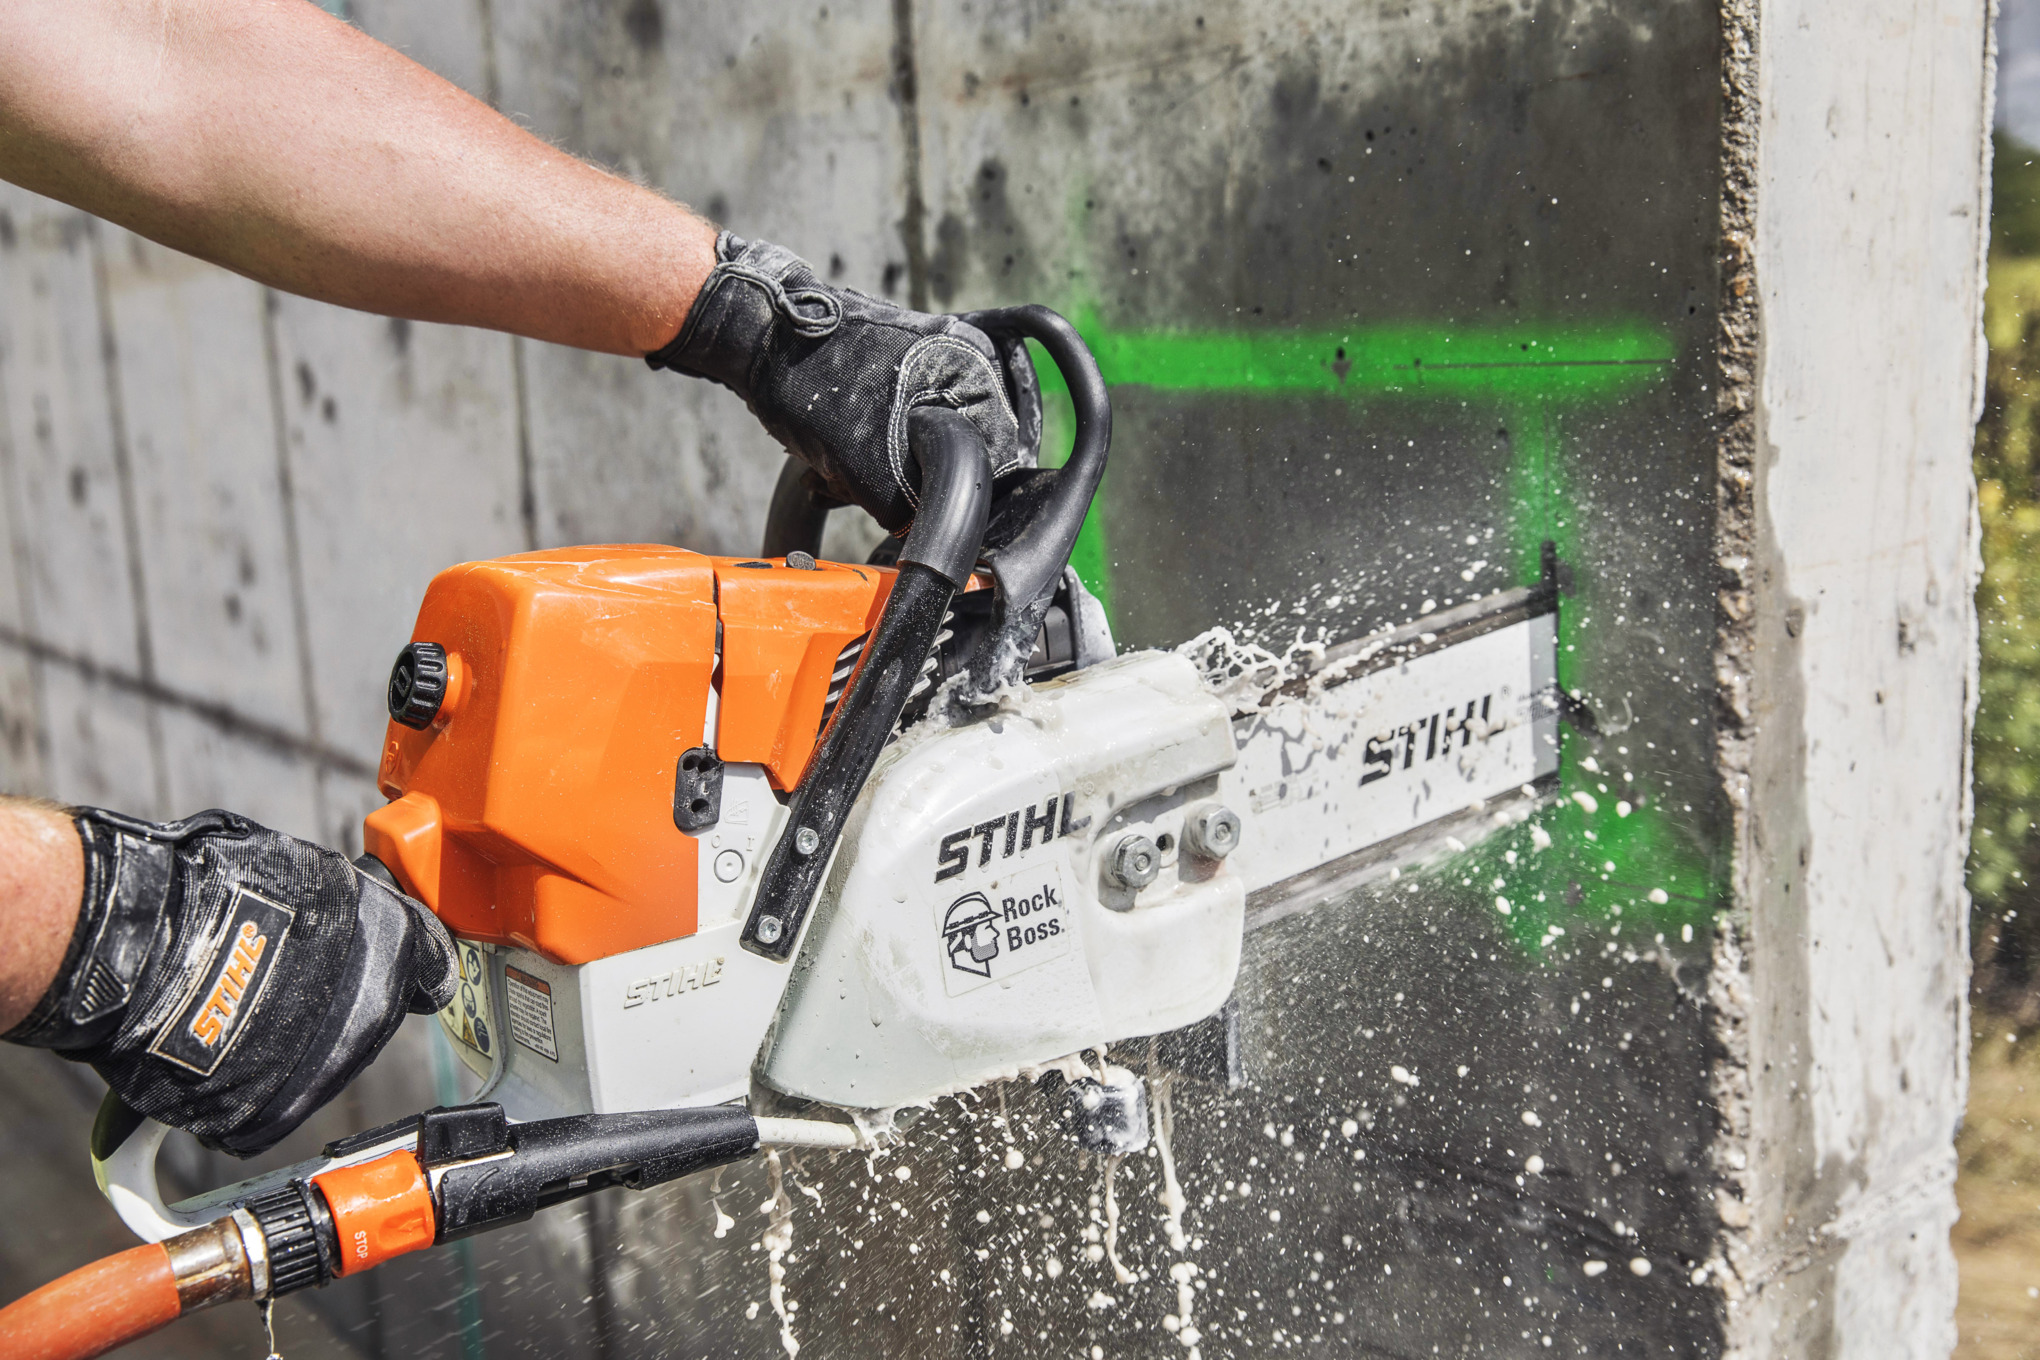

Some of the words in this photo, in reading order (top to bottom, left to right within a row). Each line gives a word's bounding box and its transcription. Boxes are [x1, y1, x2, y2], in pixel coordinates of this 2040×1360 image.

[934, 790, 1092, 884] STIHL
[1002, 884, 1058, 923] Rock
[354, 1231, 368, 1258] STOP
